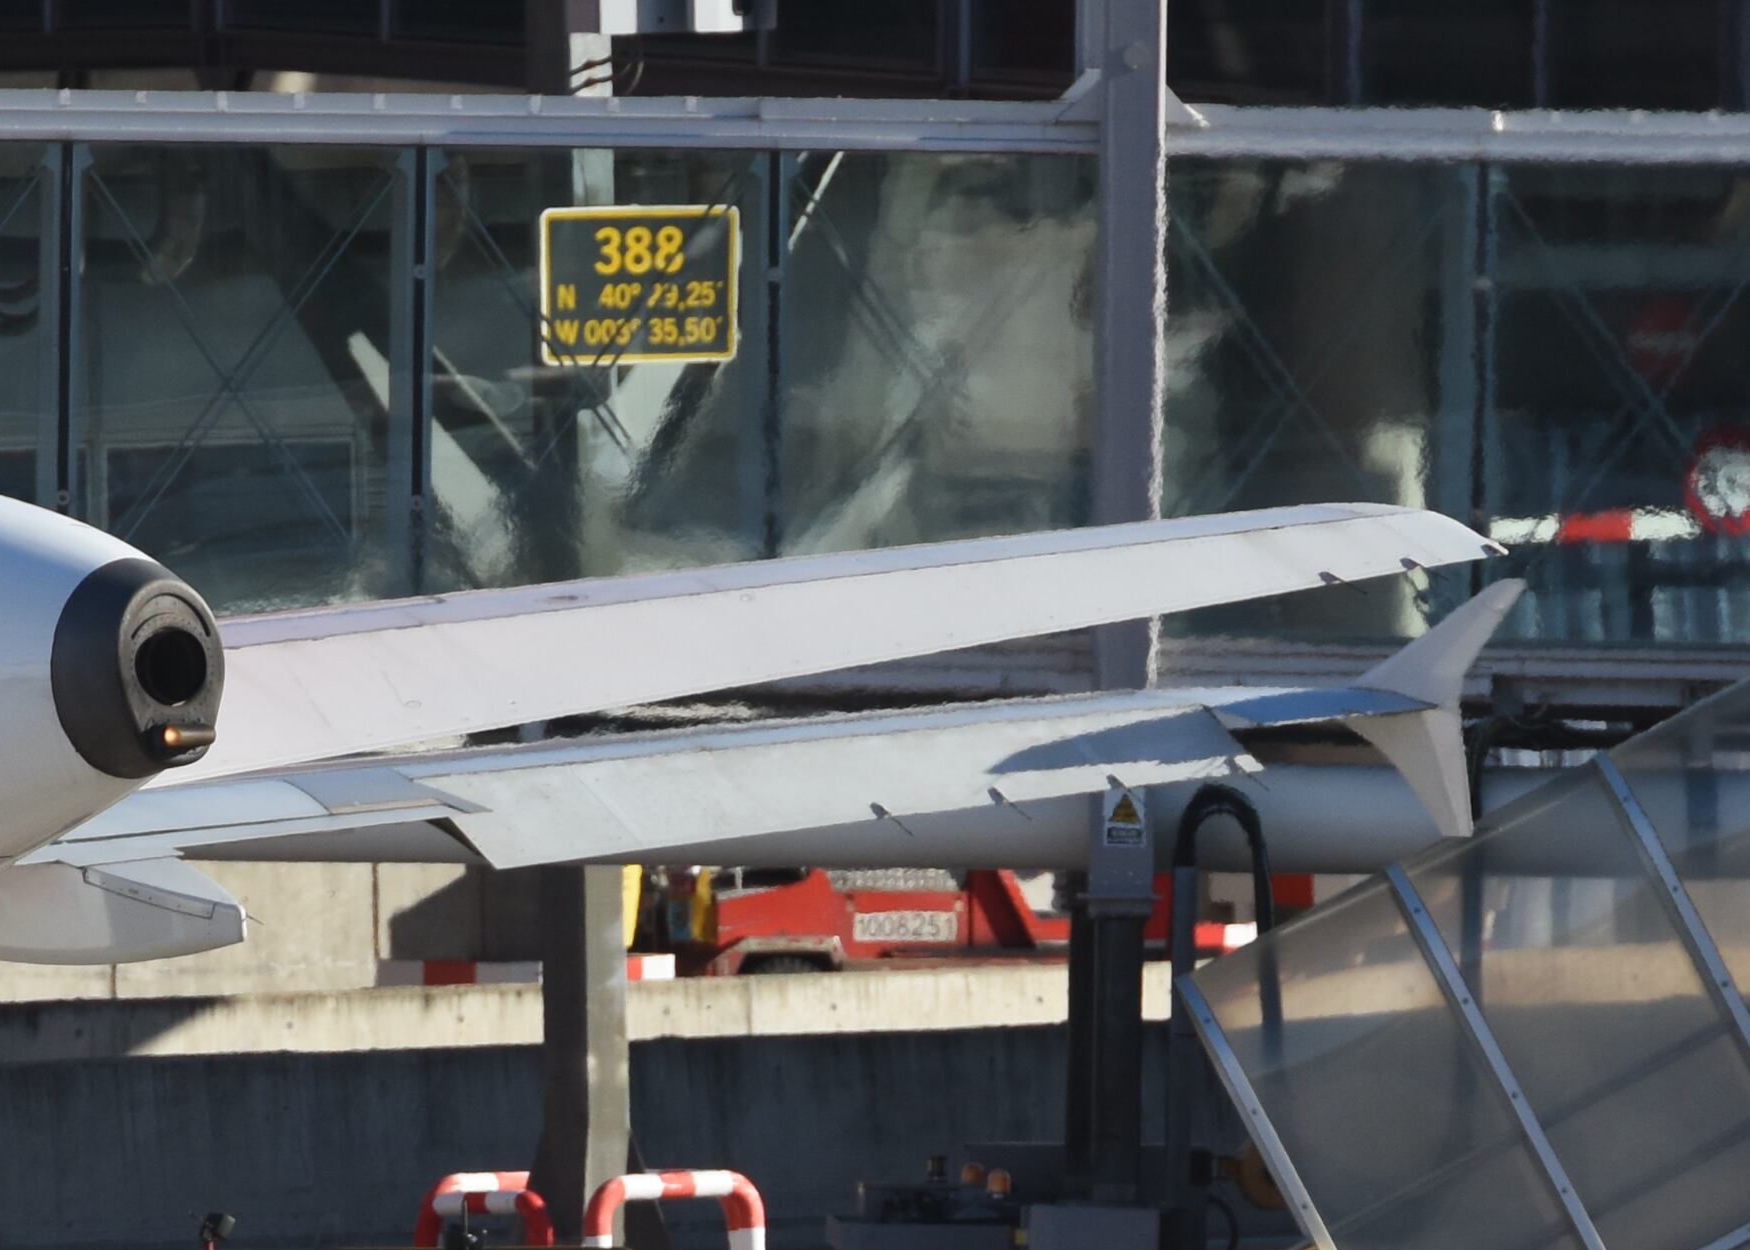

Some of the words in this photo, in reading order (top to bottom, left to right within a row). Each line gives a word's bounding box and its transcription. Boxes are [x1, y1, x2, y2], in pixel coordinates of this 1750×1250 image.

[594, 225, 684, 275] 388
[557, 283, 576, 311] N
[553, 317, 579, 346] W
